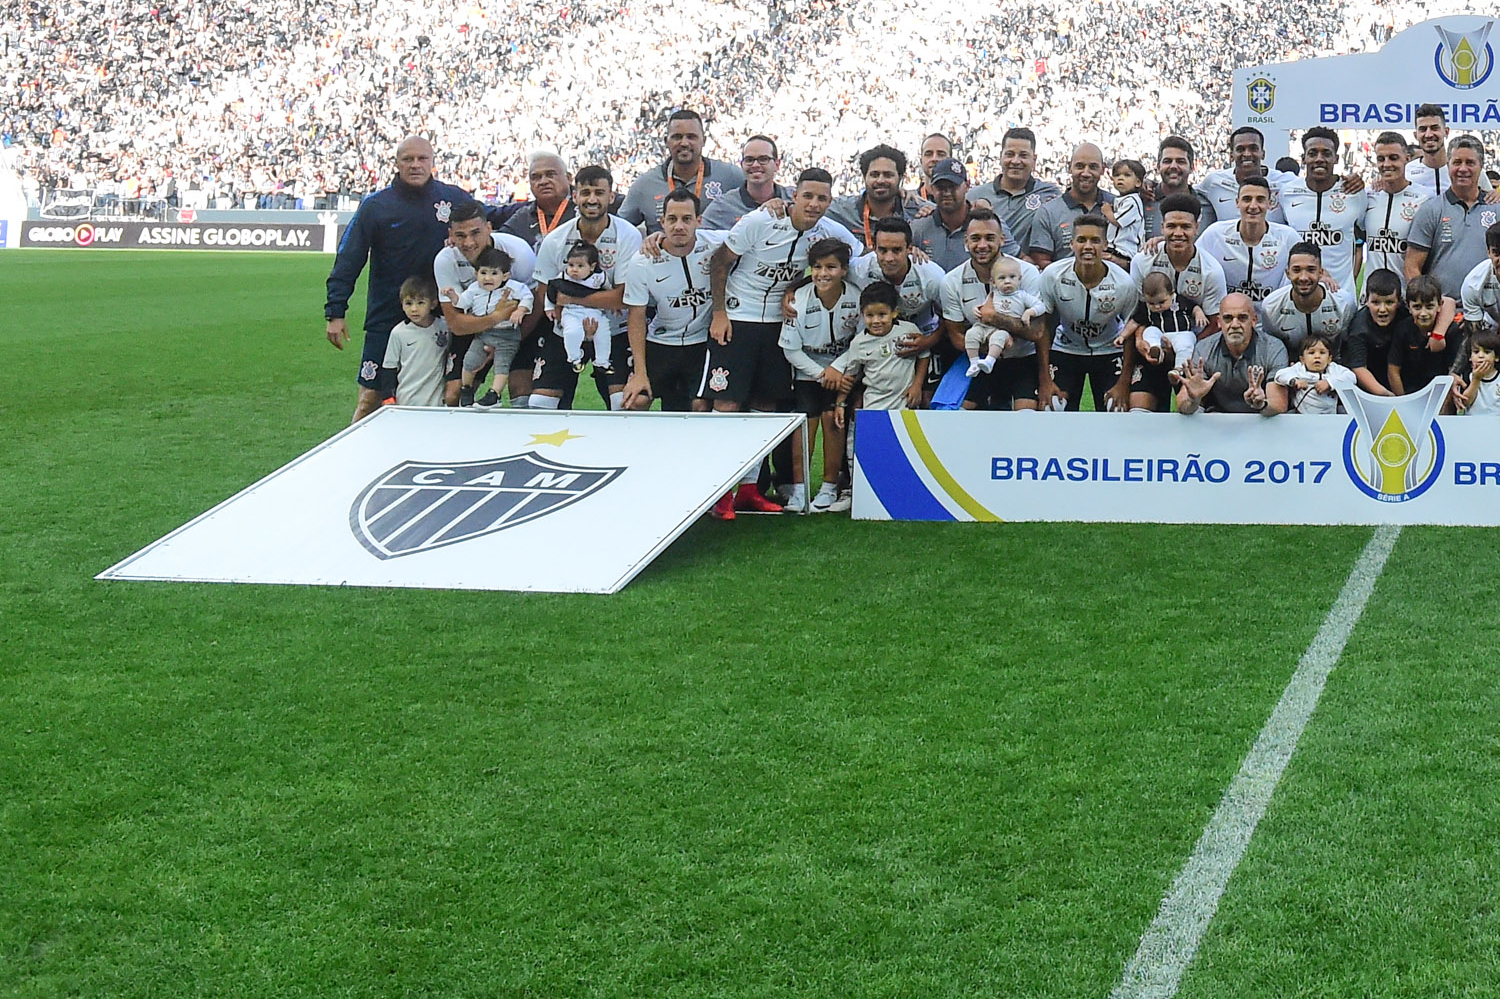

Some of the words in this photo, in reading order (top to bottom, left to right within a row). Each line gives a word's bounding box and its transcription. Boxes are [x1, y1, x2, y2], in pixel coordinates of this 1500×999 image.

[138, 227, 200, 245] ASSINE
[203, 228, 311, 247] GLOBOPLAY.
[412, 469, 581, 489] CAM
[991, 454, 1230, 483] BRASILEIRÃO
[1244, 460, 1332, 484] 2017
